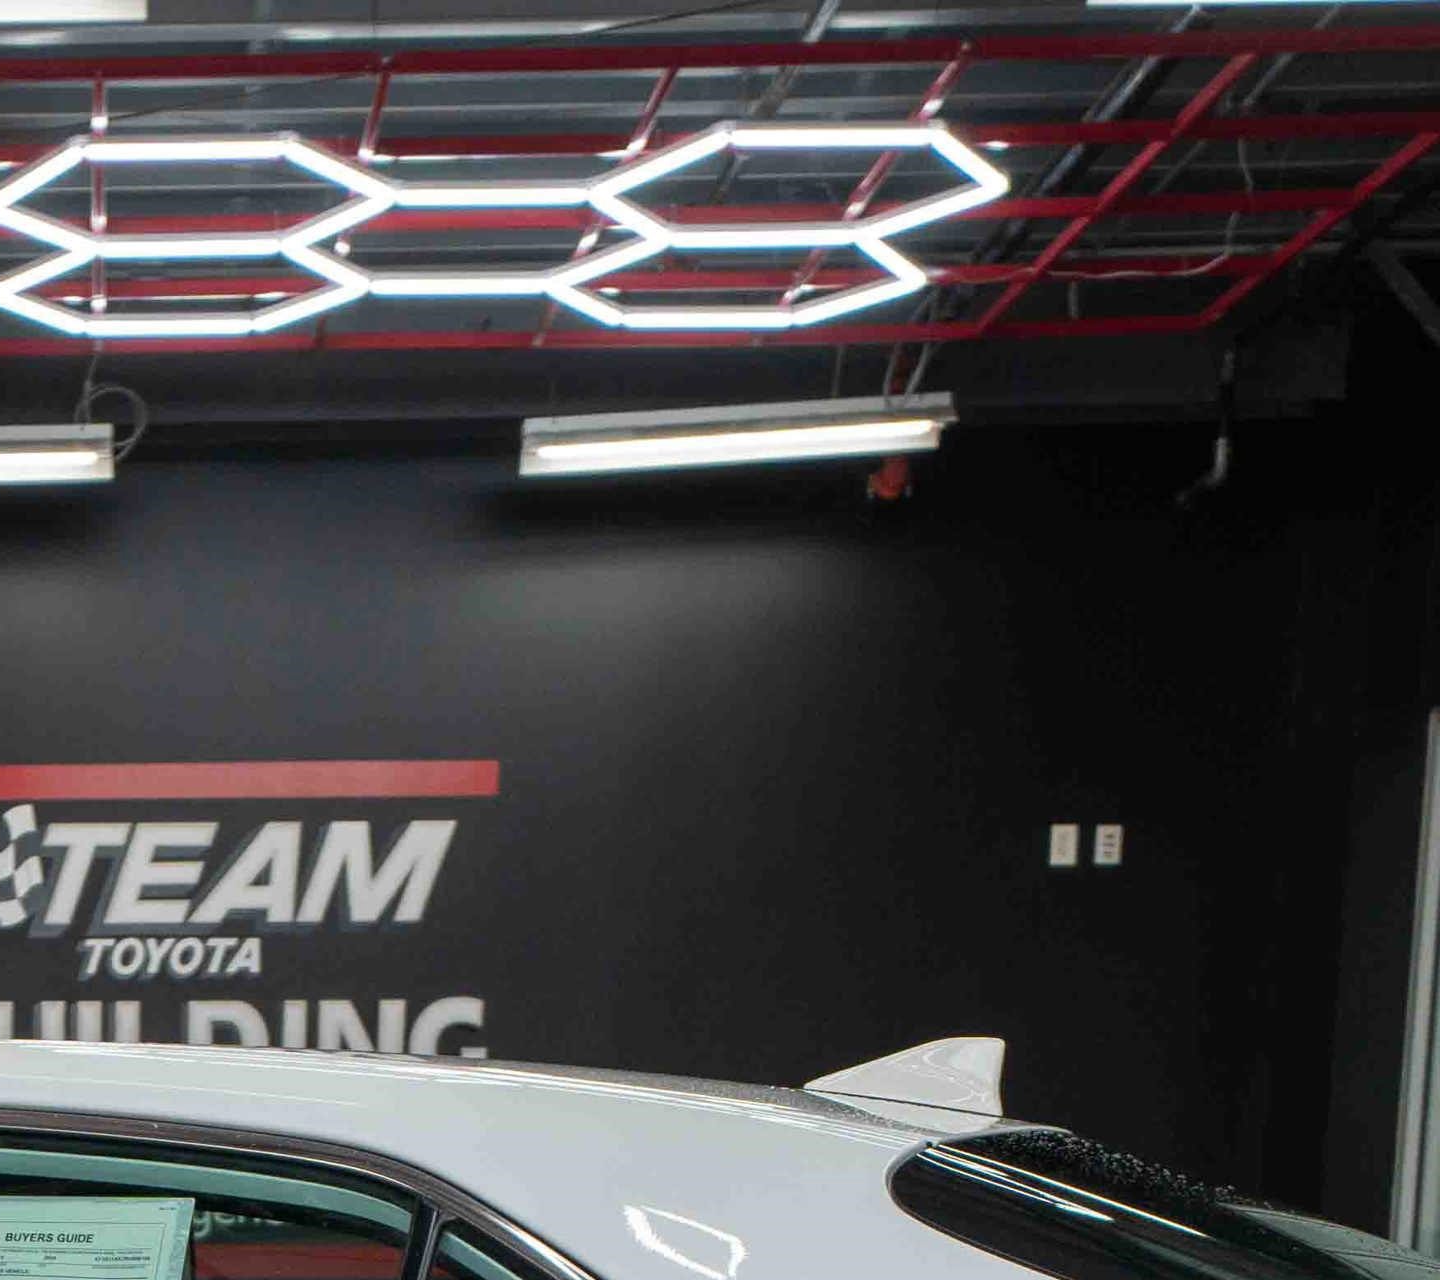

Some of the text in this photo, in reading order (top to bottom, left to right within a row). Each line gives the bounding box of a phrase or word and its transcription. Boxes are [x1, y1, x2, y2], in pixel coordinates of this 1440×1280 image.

[38, 819, 458, 926] TEAM
[78, 936, 263, 976] TOYOTA
[4, 1232, 95, 1244] BUYERS GUIDE
